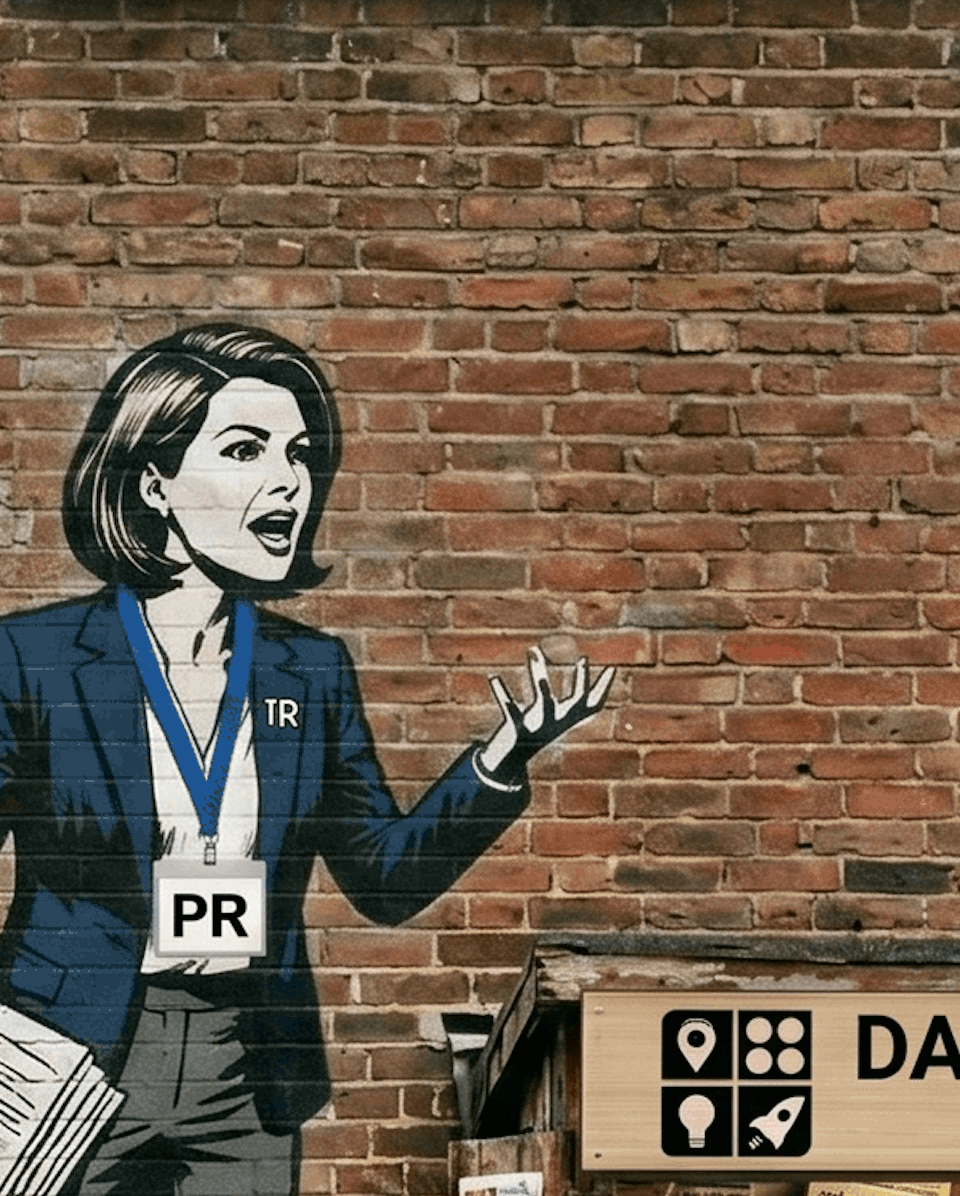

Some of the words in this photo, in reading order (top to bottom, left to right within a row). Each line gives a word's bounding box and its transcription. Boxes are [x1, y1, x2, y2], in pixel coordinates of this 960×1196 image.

[264, 697, 300, 729] TR
[172, 893, 249, 938] PR
[857, 1014, 960, 1080] DA
